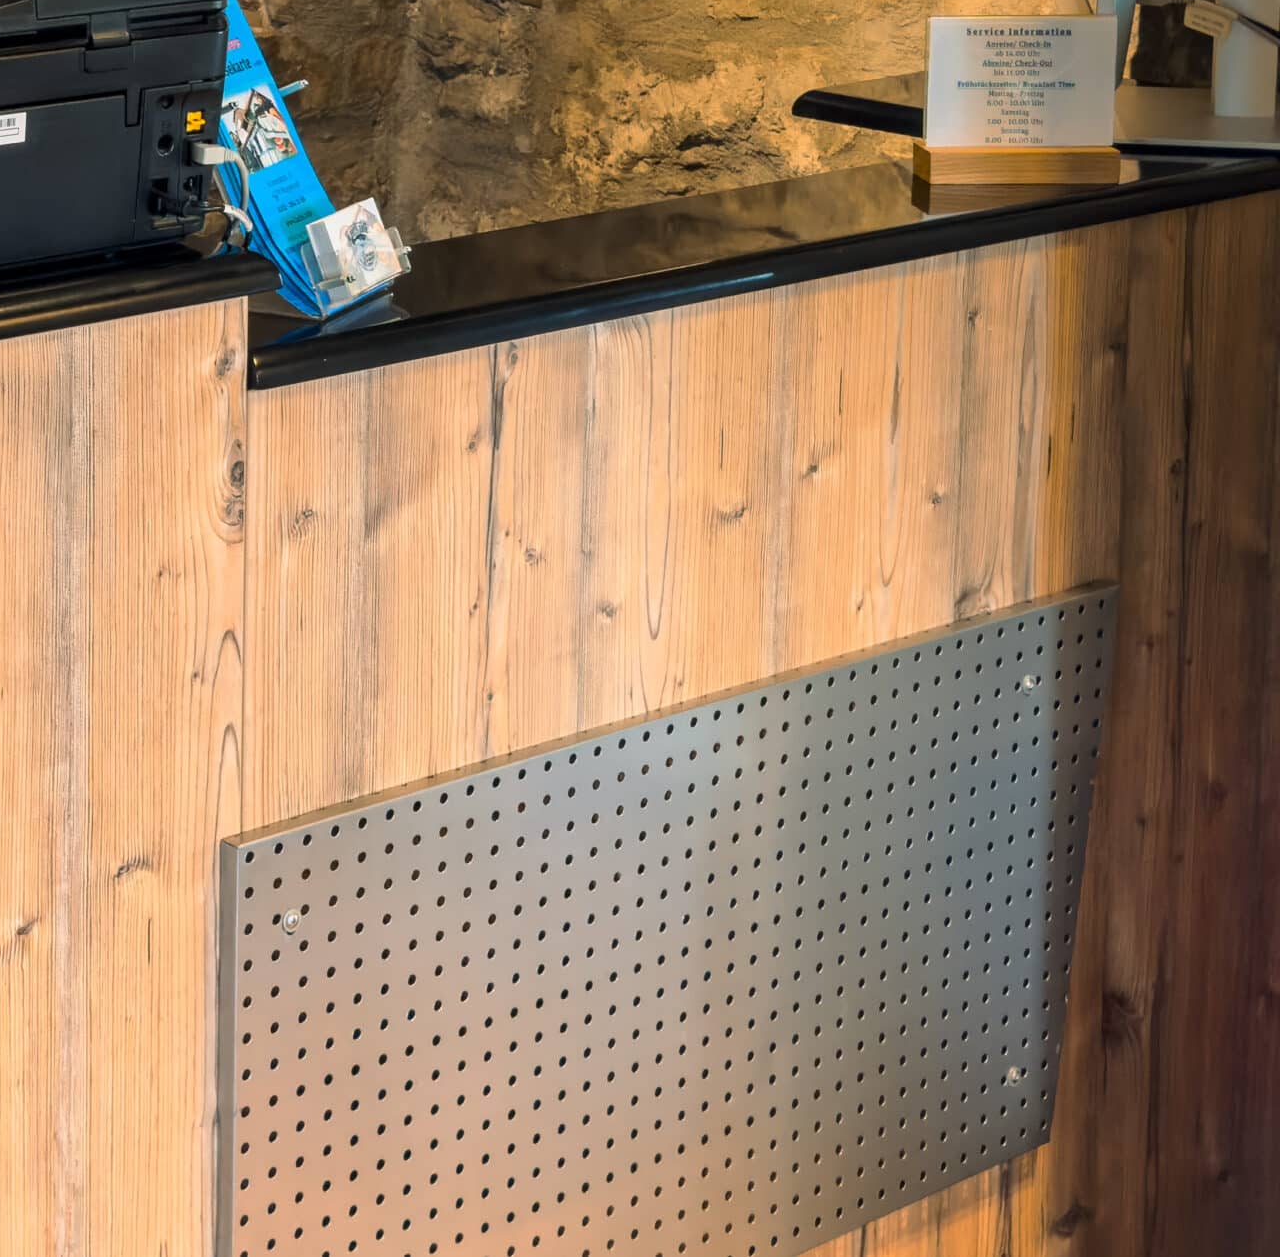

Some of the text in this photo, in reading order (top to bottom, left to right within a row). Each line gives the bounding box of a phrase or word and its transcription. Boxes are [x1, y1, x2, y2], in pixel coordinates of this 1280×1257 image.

[966, 28, 1072, 36] Service Information
[1018, 41, 1051, 49] Check-In
[1014, 60, 1053, 68] Check-Out
[1058, 81, 1076, 89] Time
